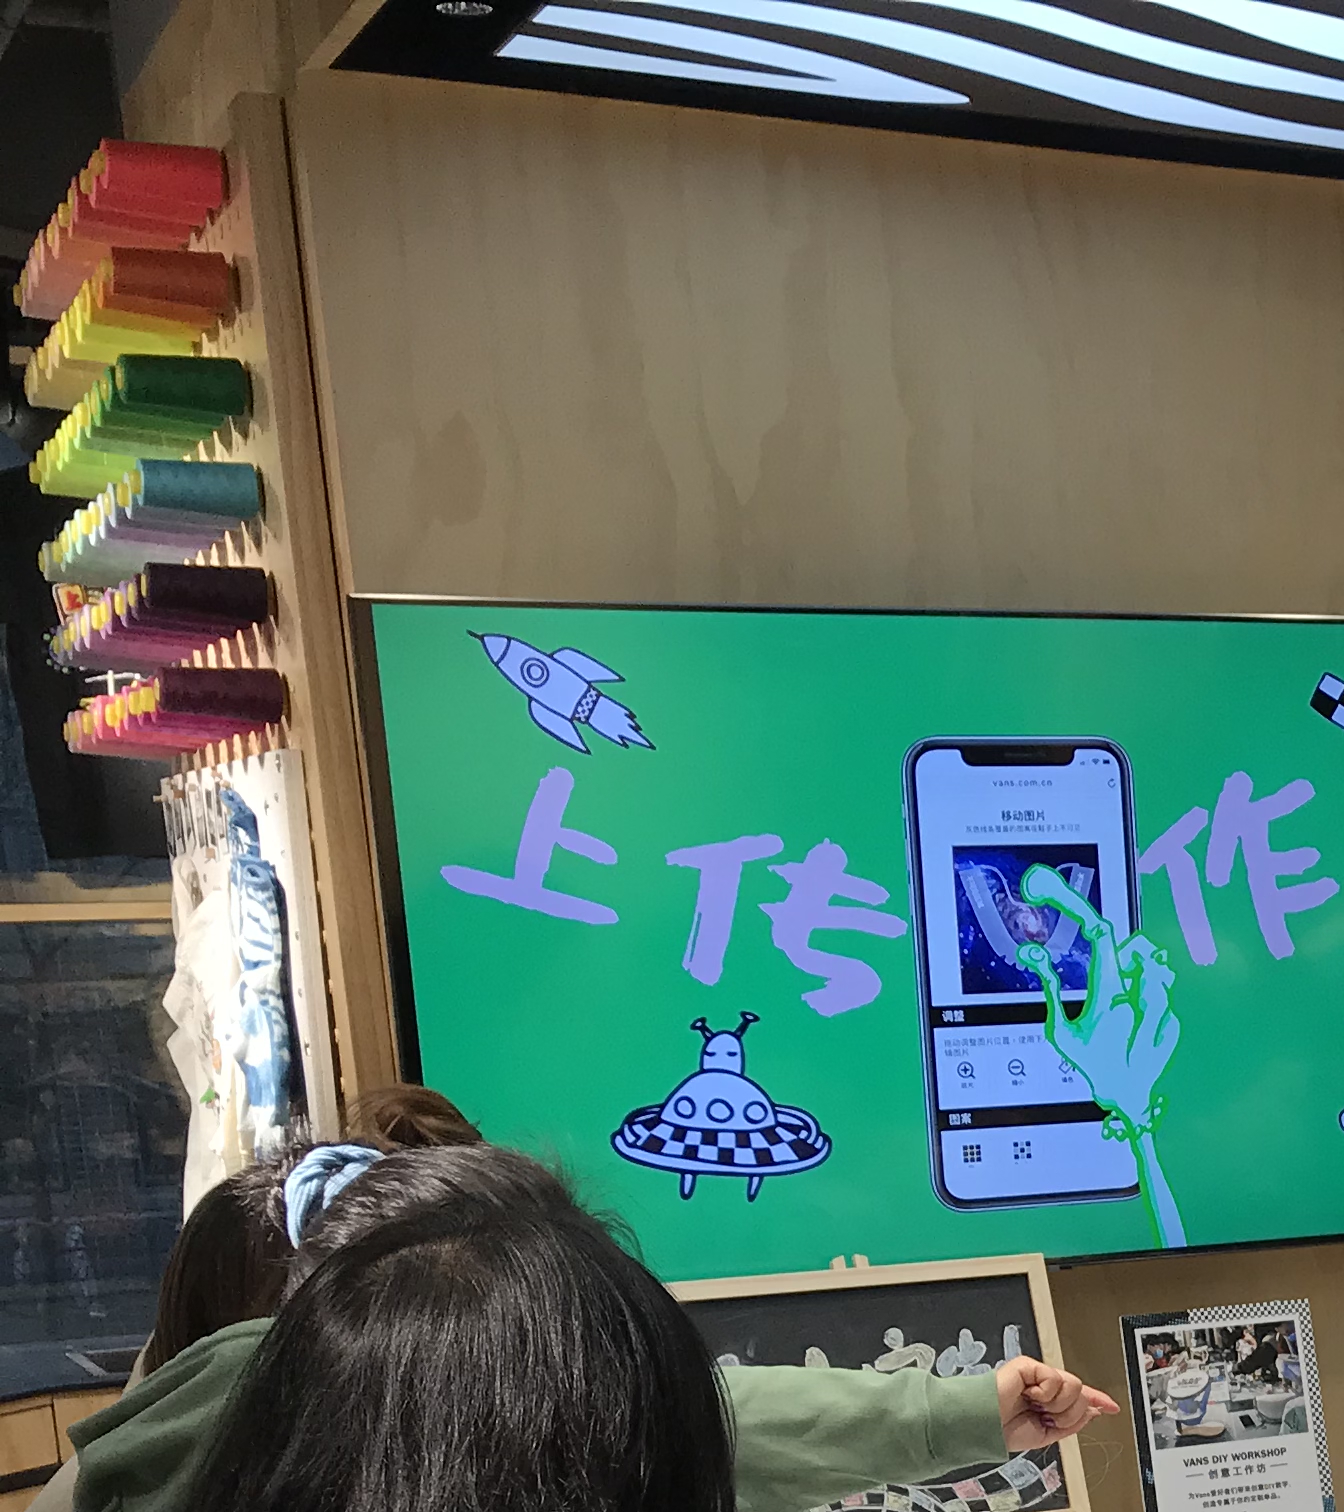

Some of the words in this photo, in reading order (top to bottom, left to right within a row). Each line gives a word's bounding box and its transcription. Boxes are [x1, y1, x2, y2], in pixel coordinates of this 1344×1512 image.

[992, 779, 1053, 788] vans.com.cn
[1001, 809, 1046, 822] 移动图片
[440, 765, 908, 1018] 上传
[941, 1010, 965, 1023] 调整
[948, 1113, 972, 1125] 图案
[1183, 1456, 1209, 1468] VANS
[1212, 1454, 1229, 1464] DIY
[1231, 1447, 1287, 1462] WORKSHOP
[1208, 1464, 1267, 1480] 创意工作坊
